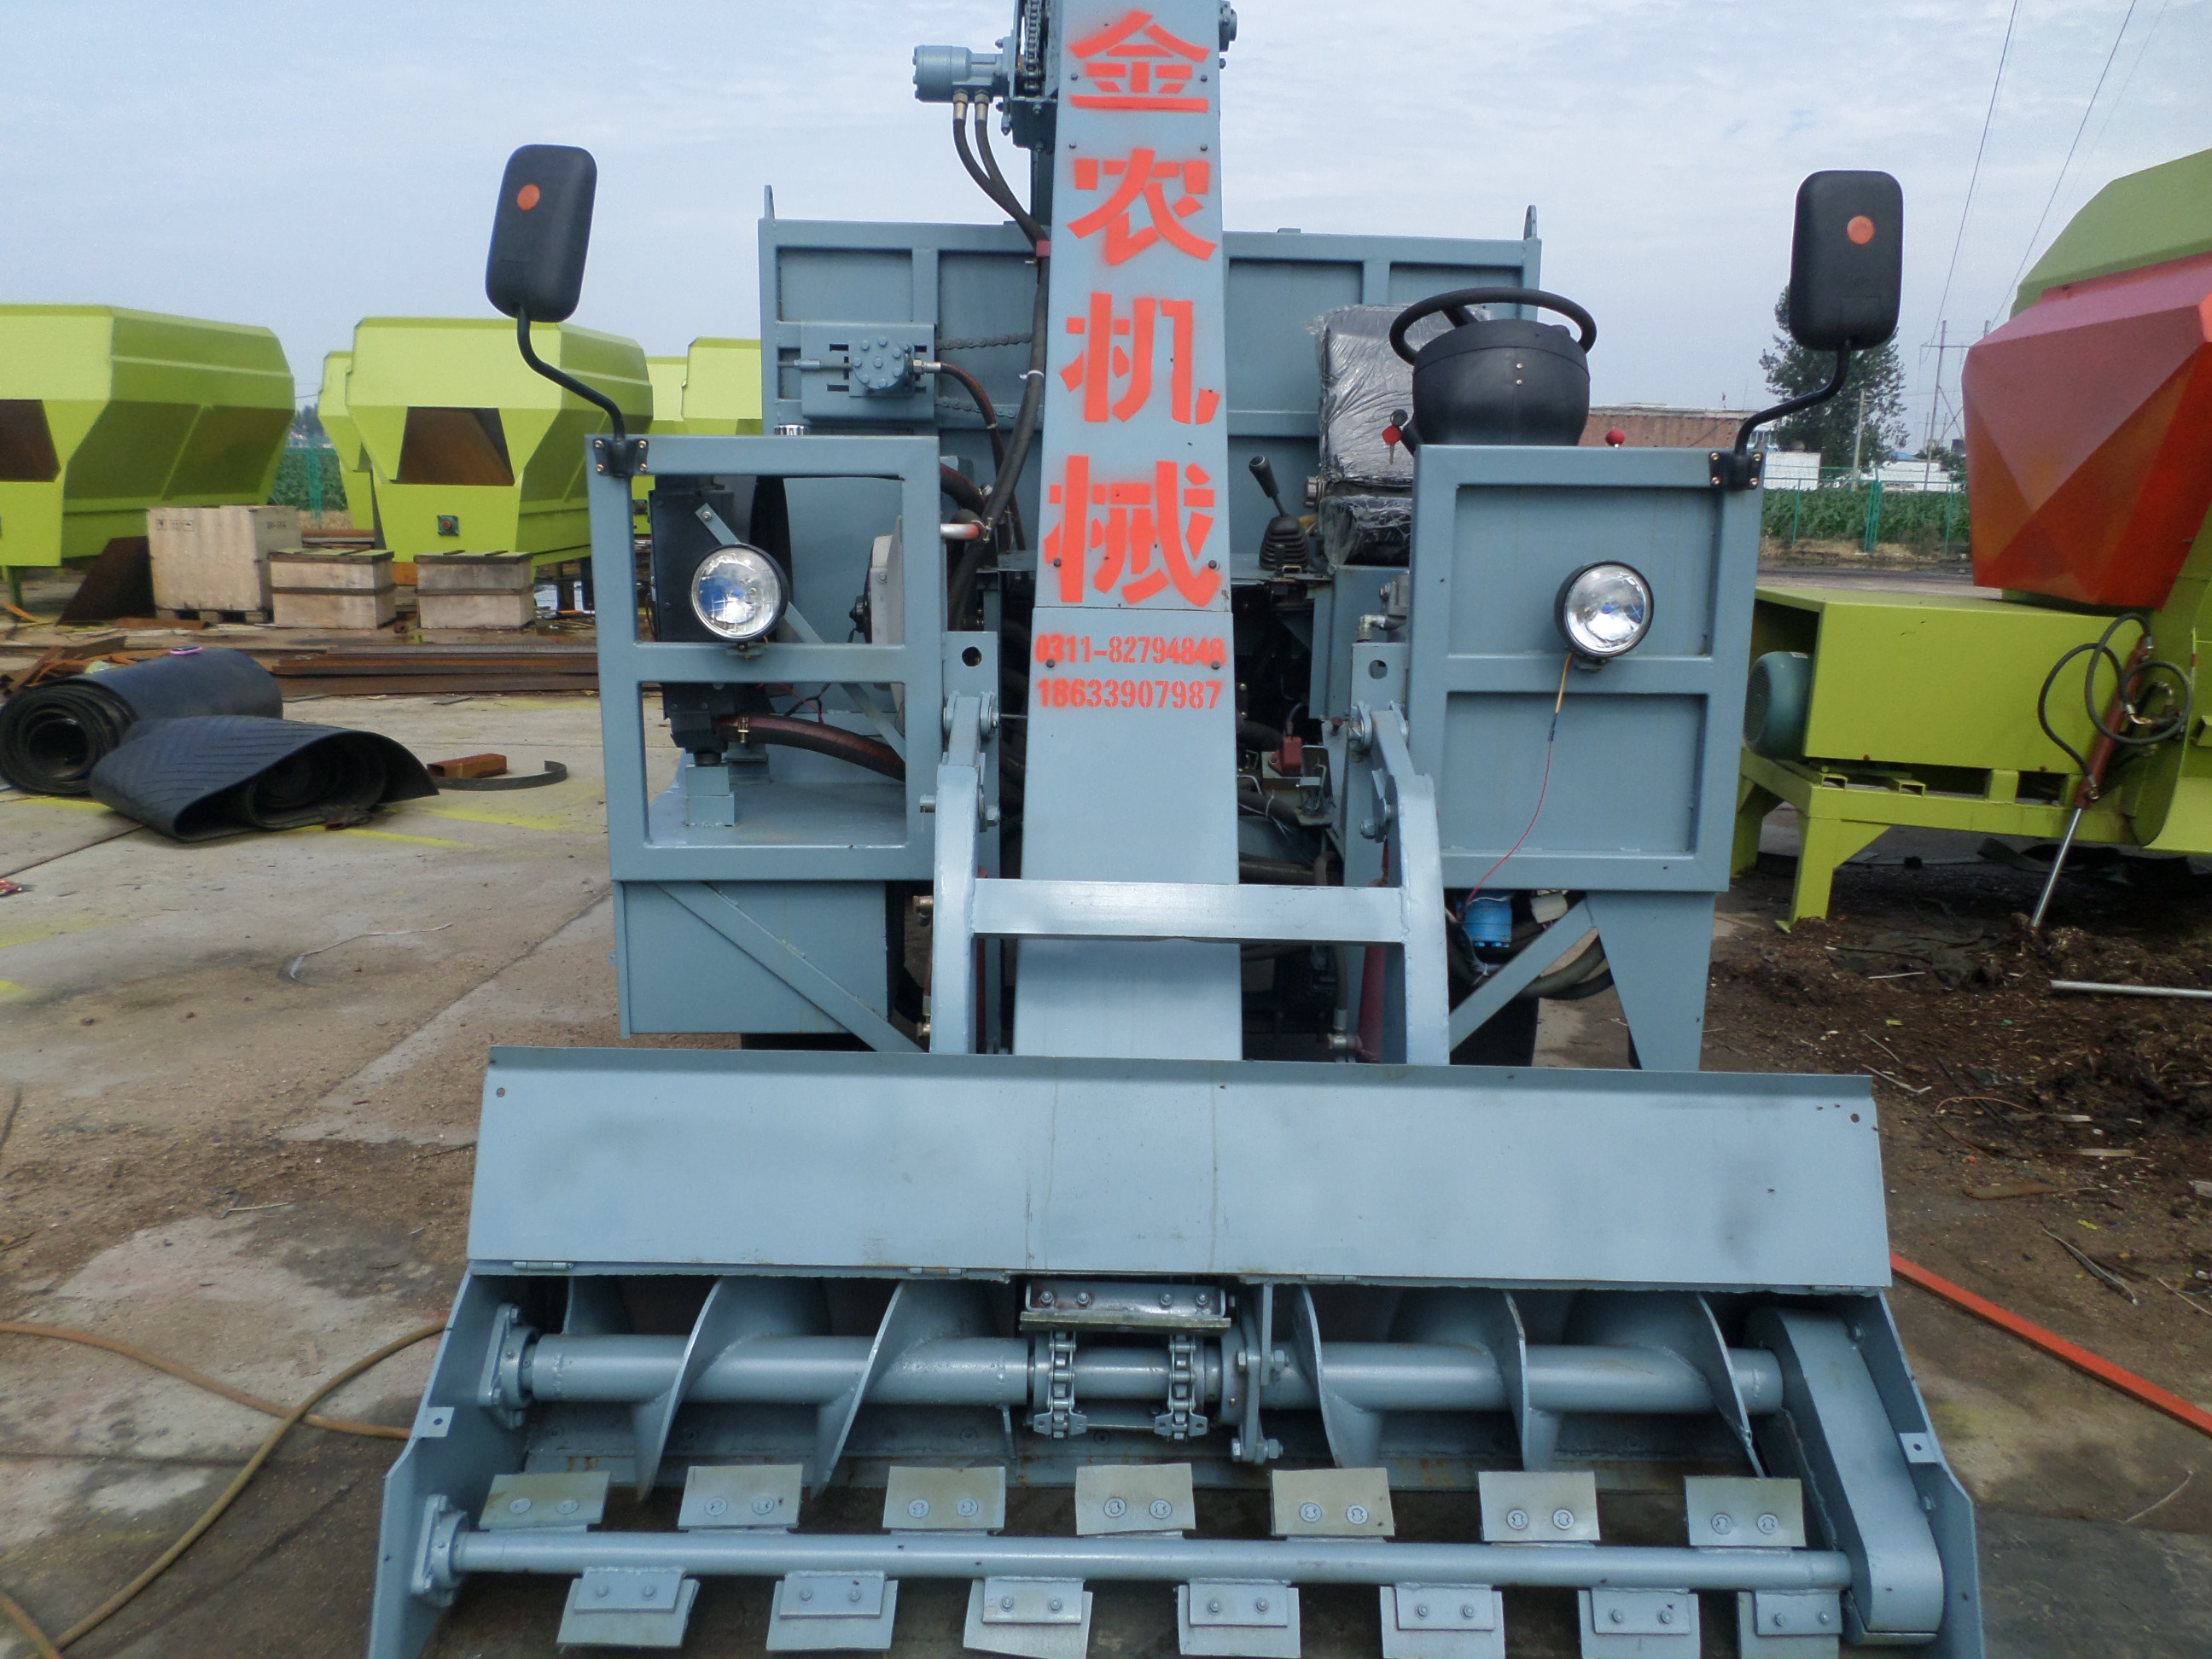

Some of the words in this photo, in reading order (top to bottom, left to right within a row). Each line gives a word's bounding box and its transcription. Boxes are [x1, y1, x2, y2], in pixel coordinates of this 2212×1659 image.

[1044, 10, 1221, 607] 金农机械
[1034, 633, 1225, 666] 0311-82794848
[1036, 678, 1223, 709] 18633907987
